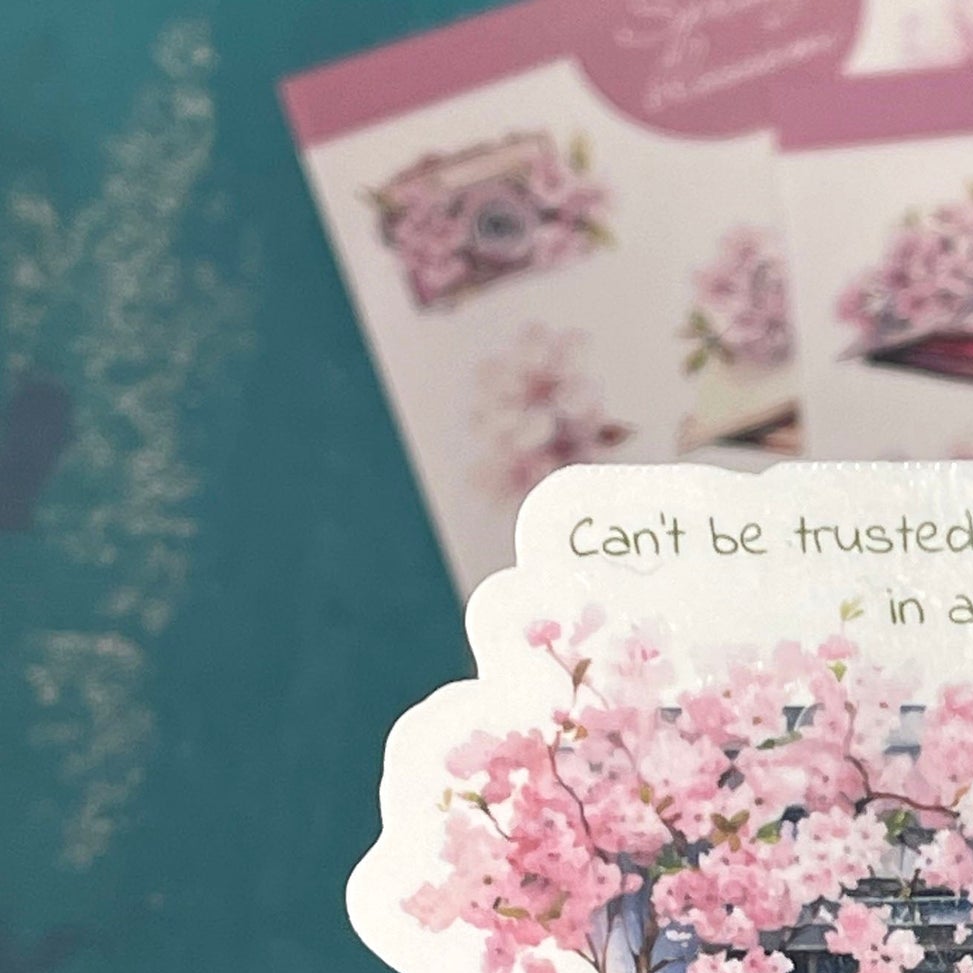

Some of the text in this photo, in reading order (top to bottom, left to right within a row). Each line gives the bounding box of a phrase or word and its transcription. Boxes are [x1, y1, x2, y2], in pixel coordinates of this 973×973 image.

[569, 511, 686, 557] Can't
[709, 516, 767, 556] be
[885, 587, 926, 626] in
